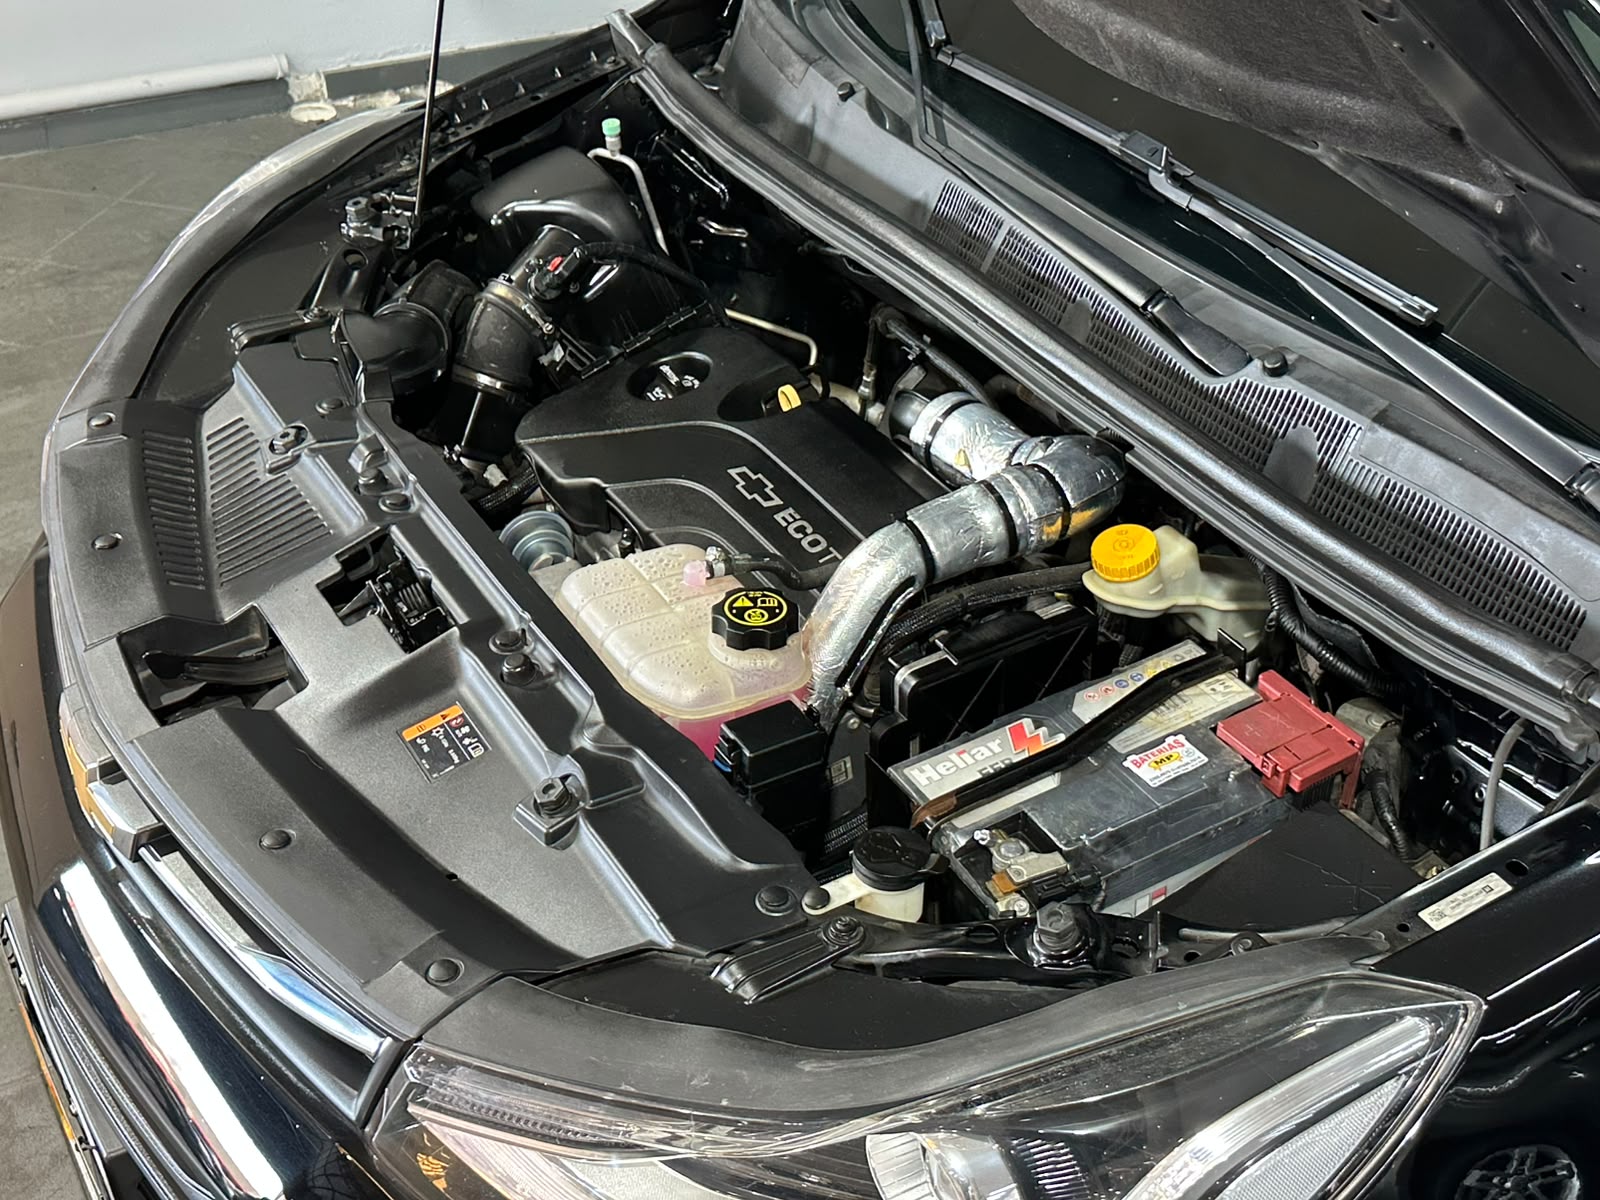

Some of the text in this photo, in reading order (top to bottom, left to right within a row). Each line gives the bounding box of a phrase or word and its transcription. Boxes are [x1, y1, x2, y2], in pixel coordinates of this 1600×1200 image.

[910, 737, 1003, 787] Heliar
[1131, 738, 1186, 769] BATERIAS
[1154, 753, 1174, 766] MP
